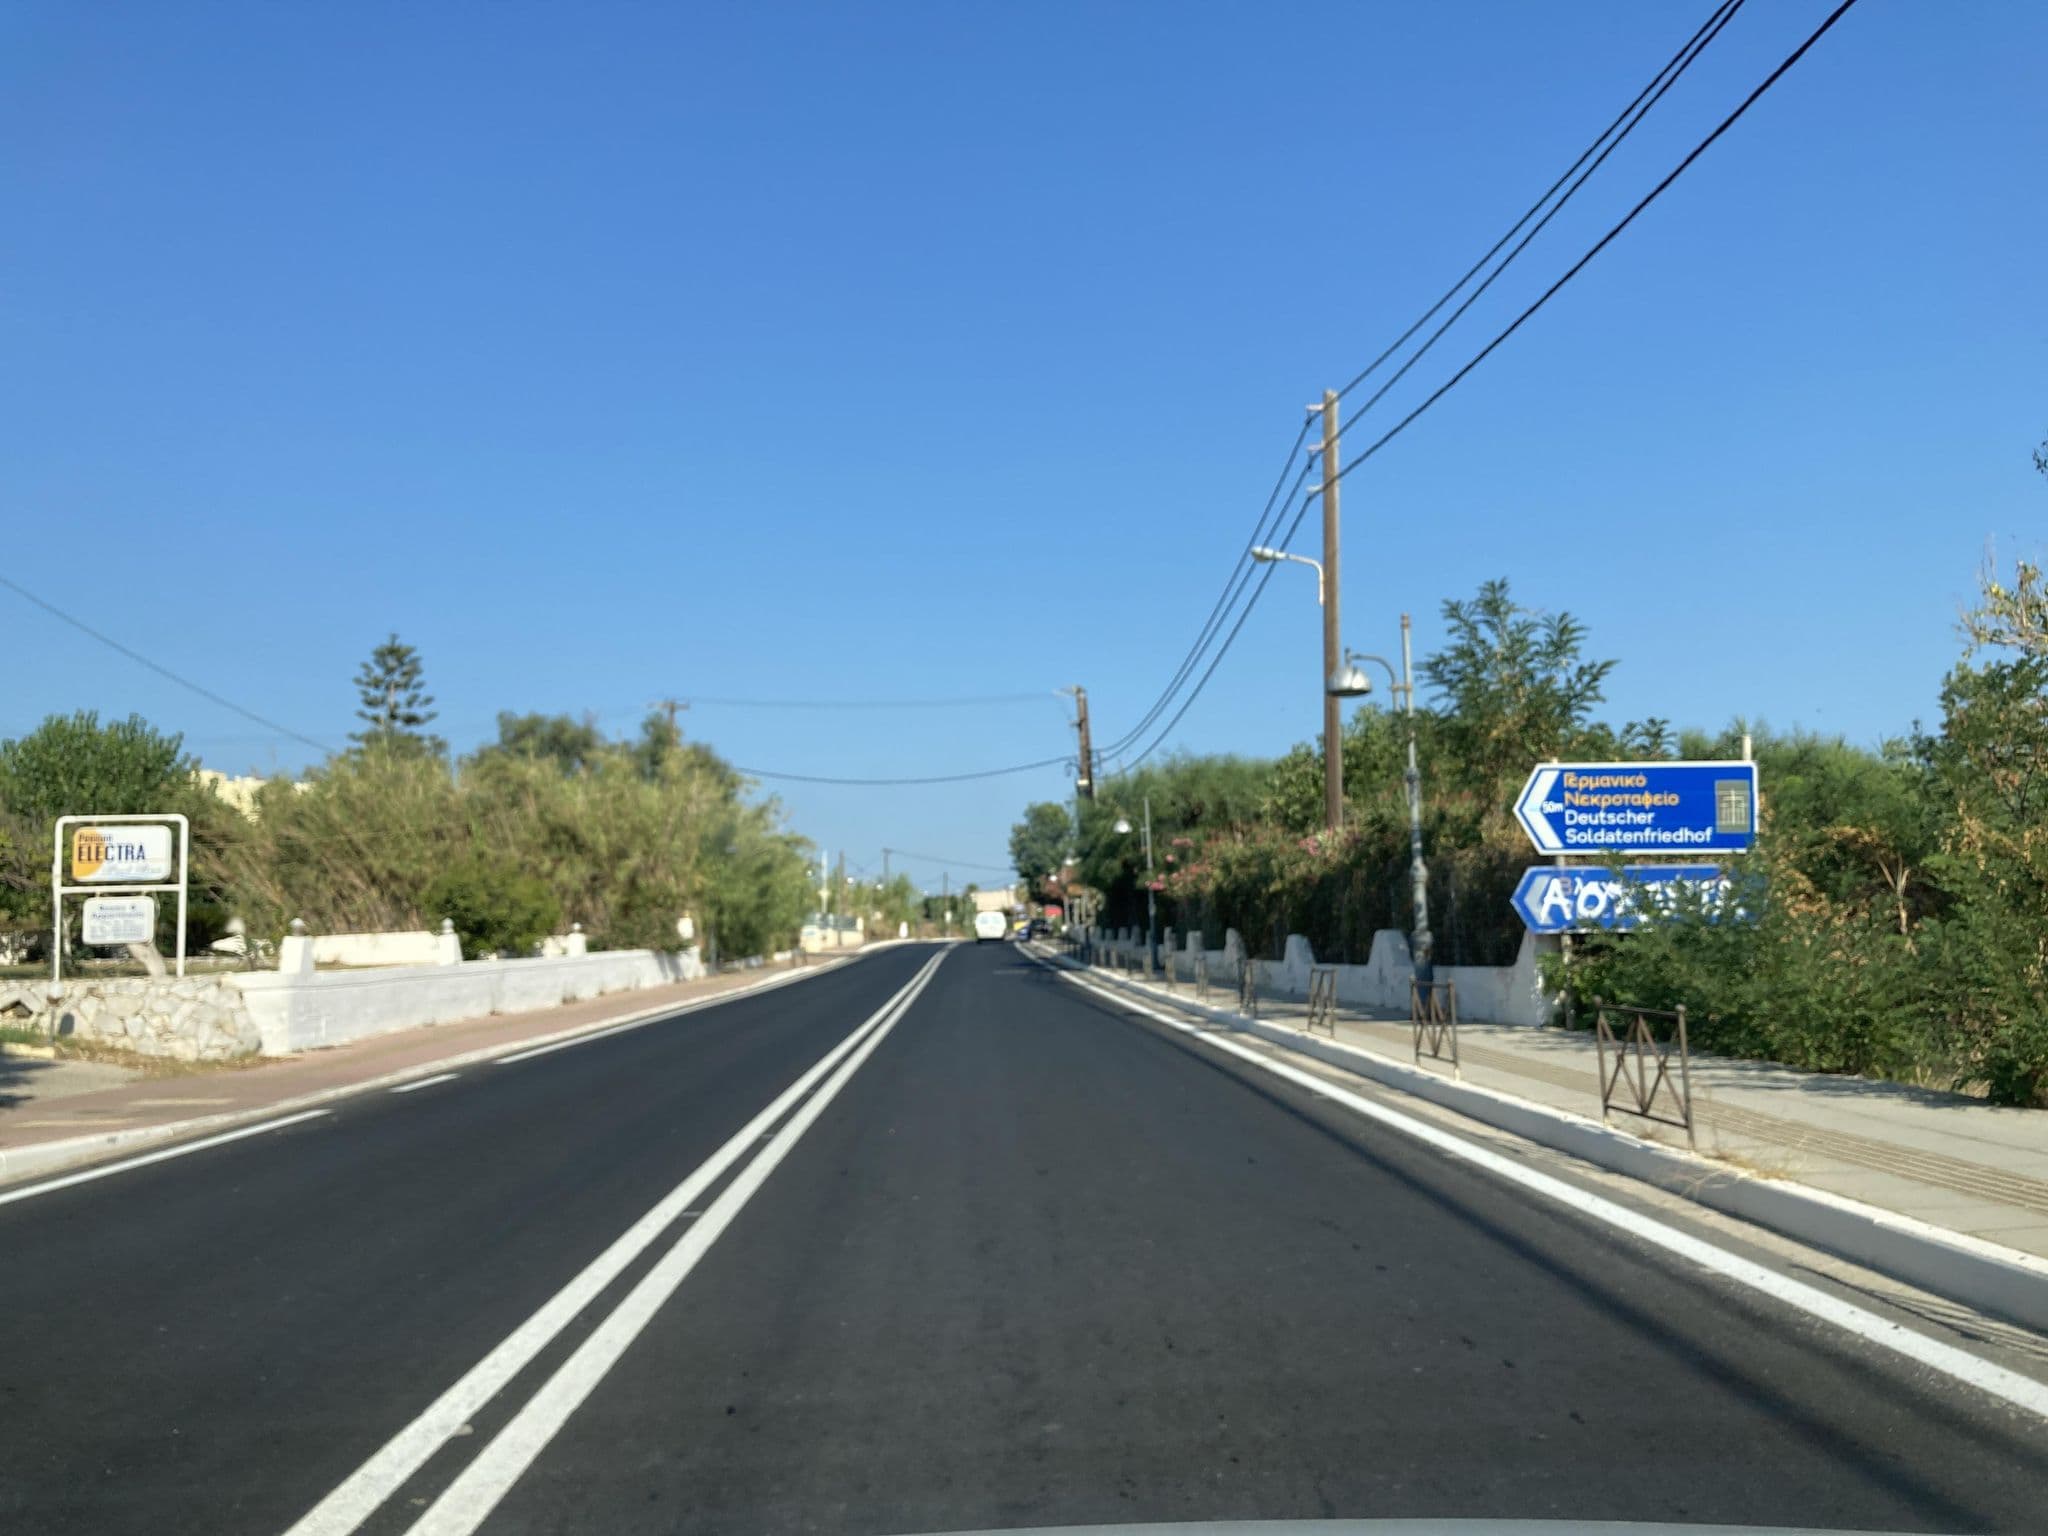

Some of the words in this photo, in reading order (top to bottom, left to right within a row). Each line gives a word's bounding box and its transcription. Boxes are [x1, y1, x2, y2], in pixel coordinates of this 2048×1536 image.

[1563, 772, 1647, 791] Γερμανικό
[1564, 790, 1680, 809] Νεκροταφείο
[1565, 809, 1655, 826] Deutscher
[1565, 826, 1713, 844] Soldatenfriedhof
[78, 844, 146, 862] ELECTRA
